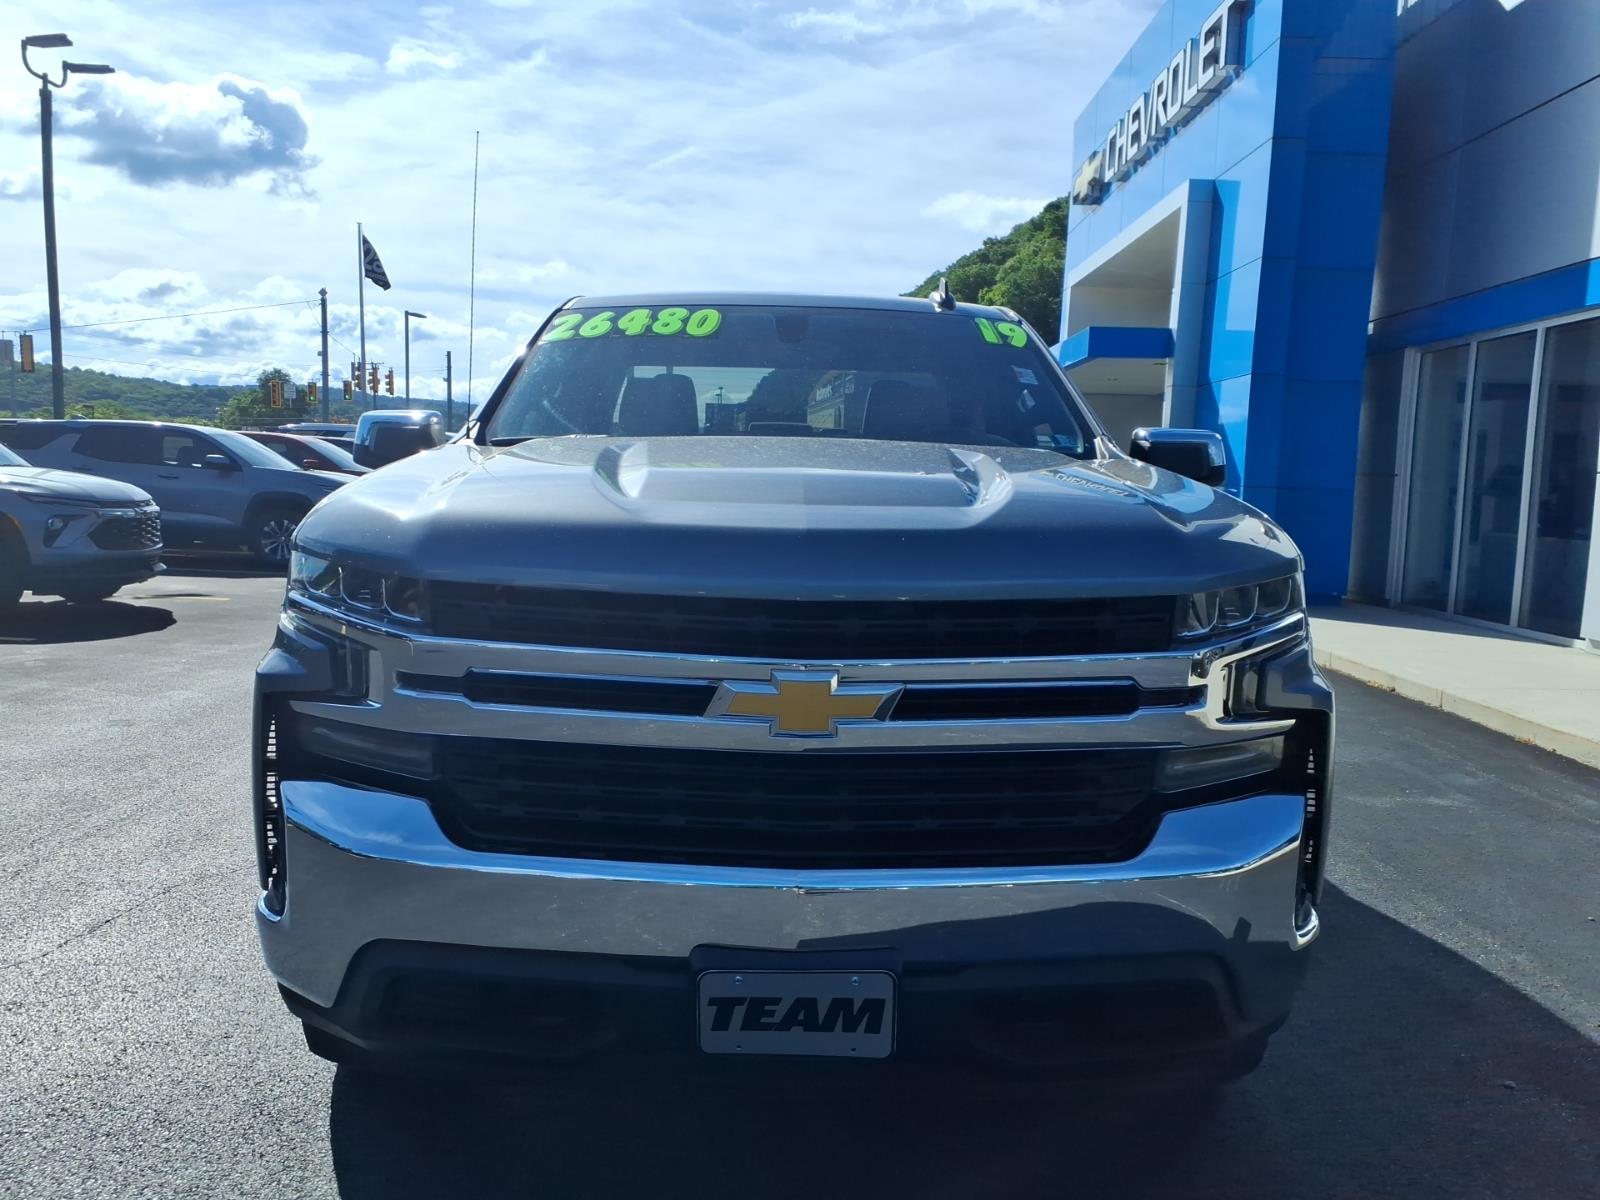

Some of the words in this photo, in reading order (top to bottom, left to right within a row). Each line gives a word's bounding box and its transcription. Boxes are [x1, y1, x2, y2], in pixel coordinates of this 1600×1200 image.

[1104, 0, 1236, 182] CHEVROLET
[542, 308, 722, 342] 26480
[974, 317, 1028, 348] 19
[707, 996, 886, 1034] TEAM
